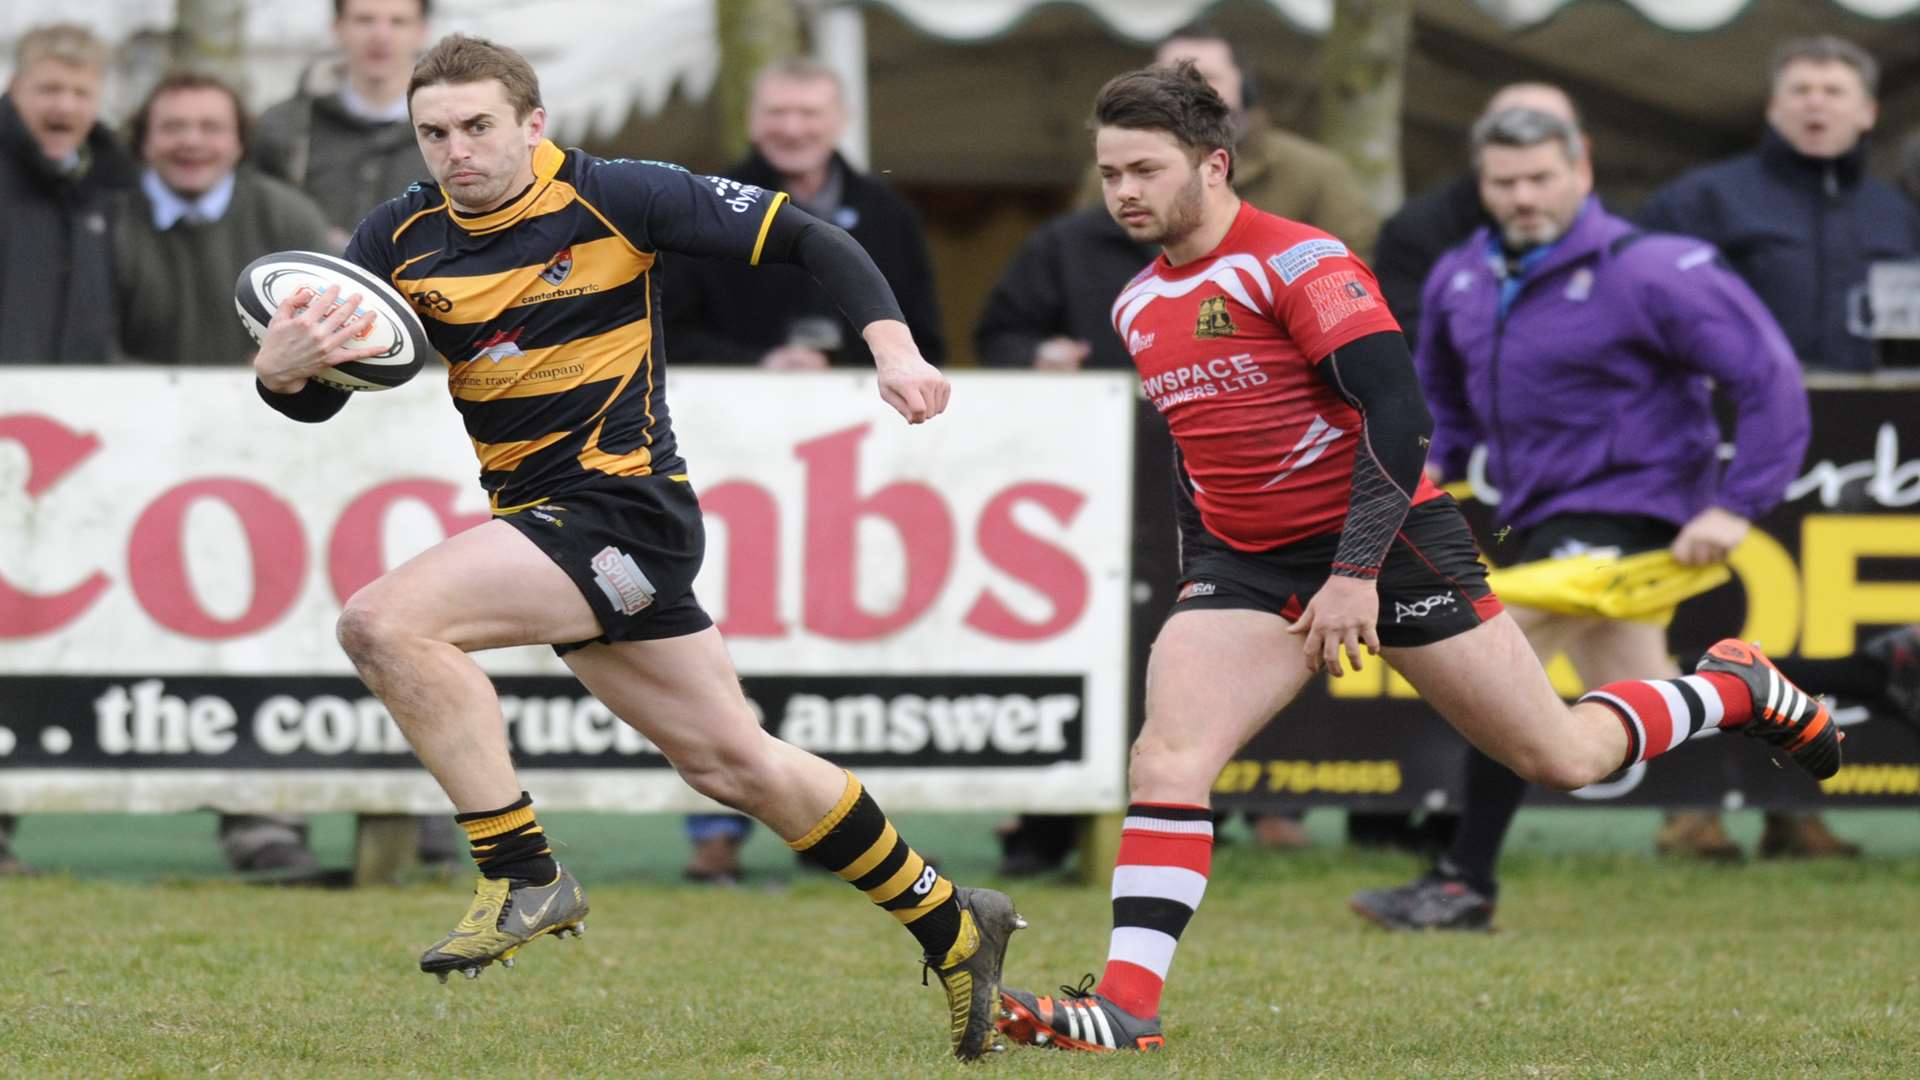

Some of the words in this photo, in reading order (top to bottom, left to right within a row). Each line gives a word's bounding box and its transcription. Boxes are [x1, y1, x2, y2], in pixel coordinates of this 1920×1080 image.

[1220, 371, 1269, 393] LTD
[598, 552, 649, 612] SPITFIRE
[96, 680, 239, 755] the
[781, 693, 1079, 754] answer
